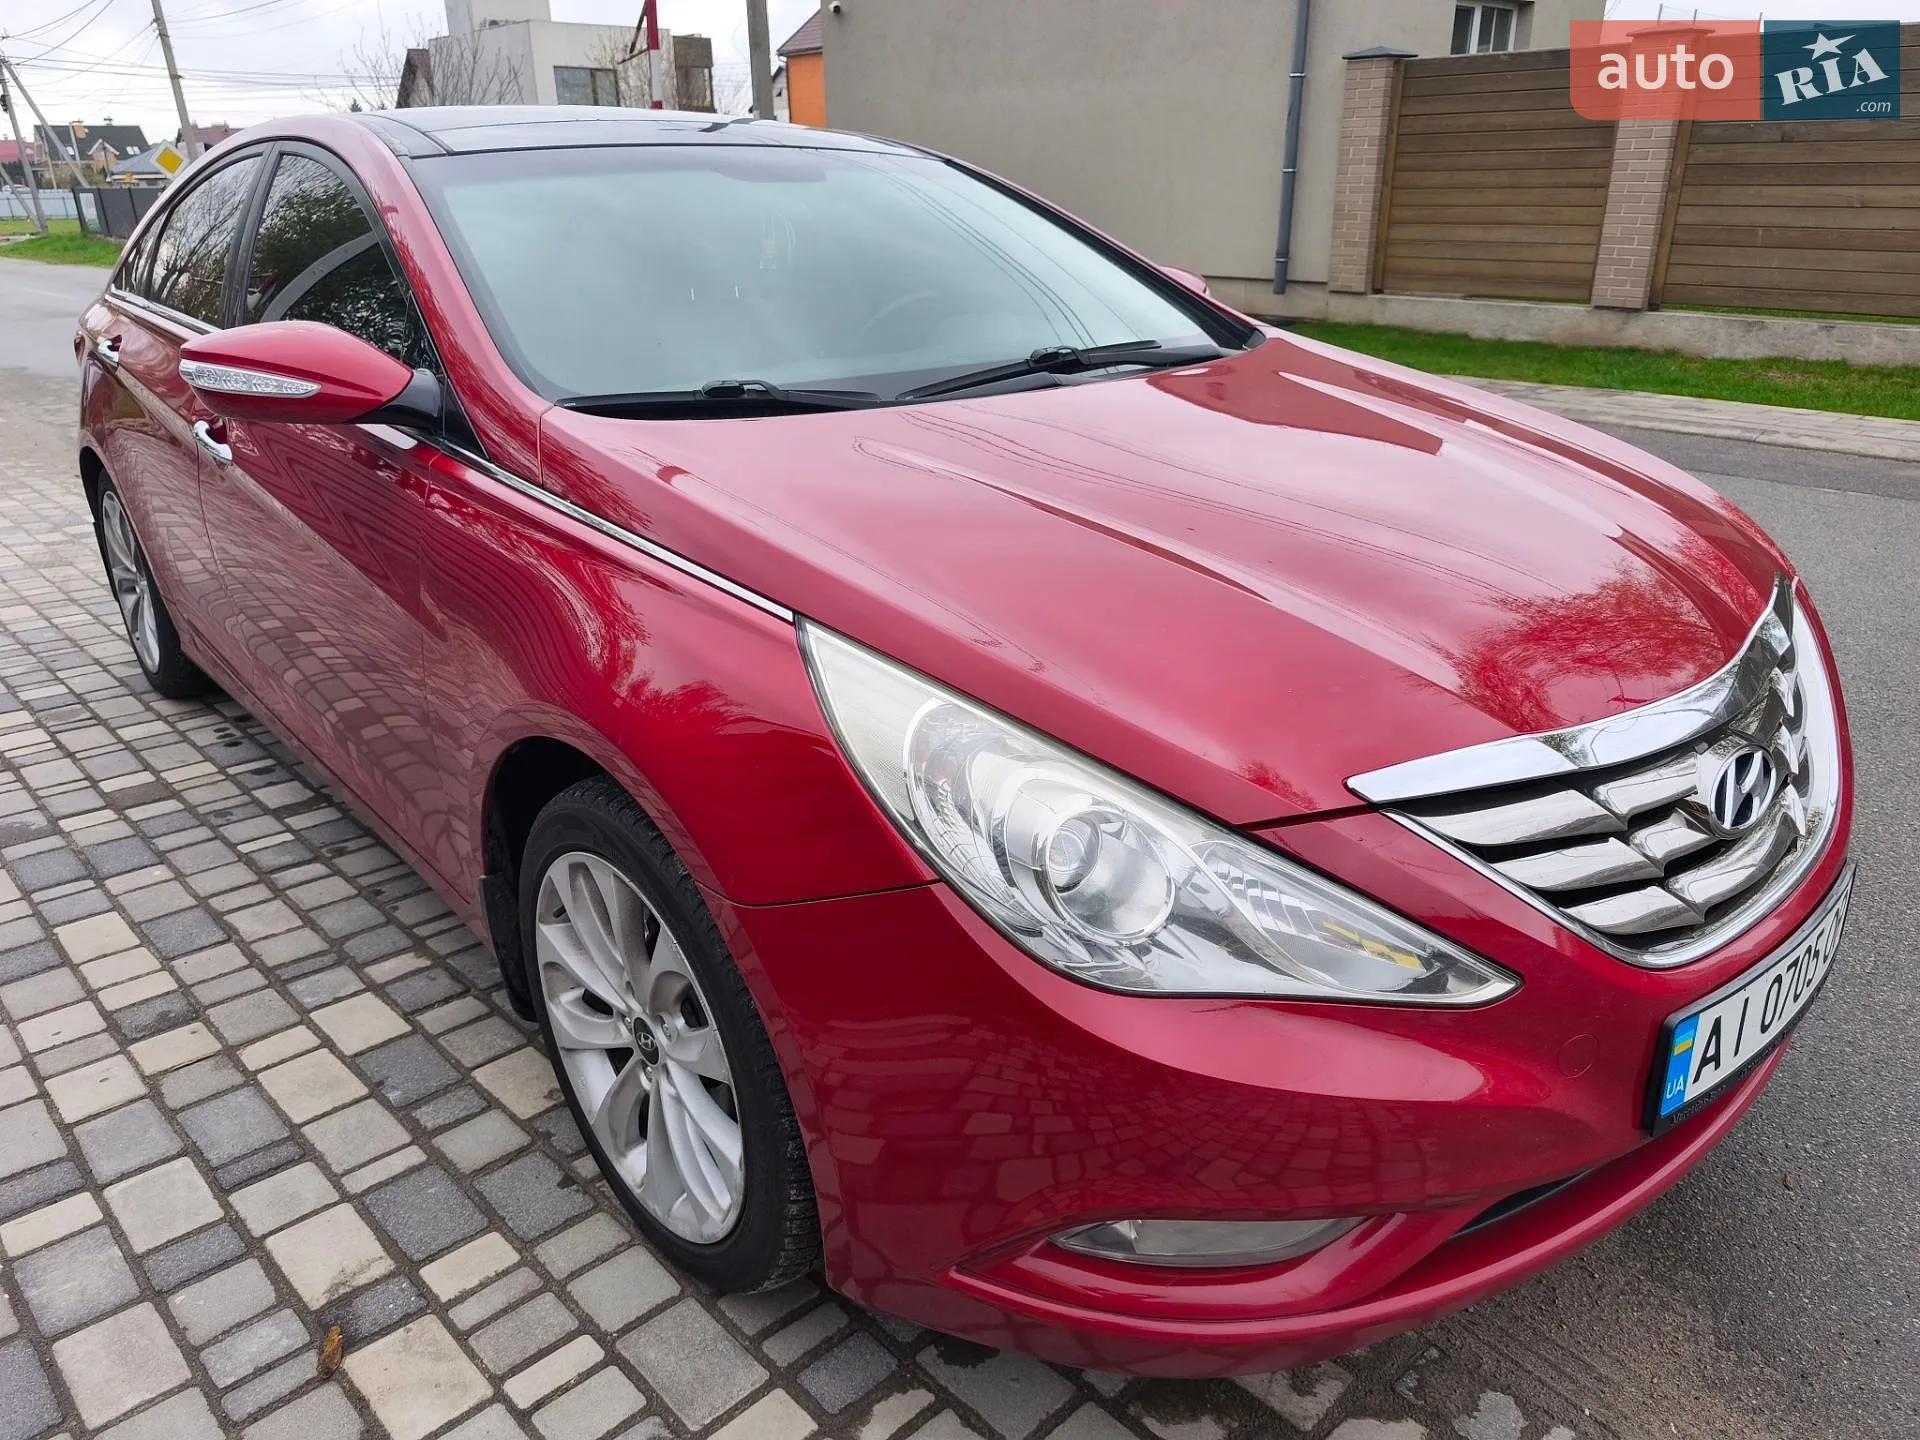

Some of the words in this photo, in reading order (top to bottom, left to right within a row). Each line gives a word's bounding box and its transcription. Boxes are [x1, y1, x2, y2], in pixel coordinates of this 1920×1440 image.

[1692, 996, 1750, 1084] AI
[1760, 928, 1825, 1035] 0705
[1666, 1074, 1684, 1099] UA
